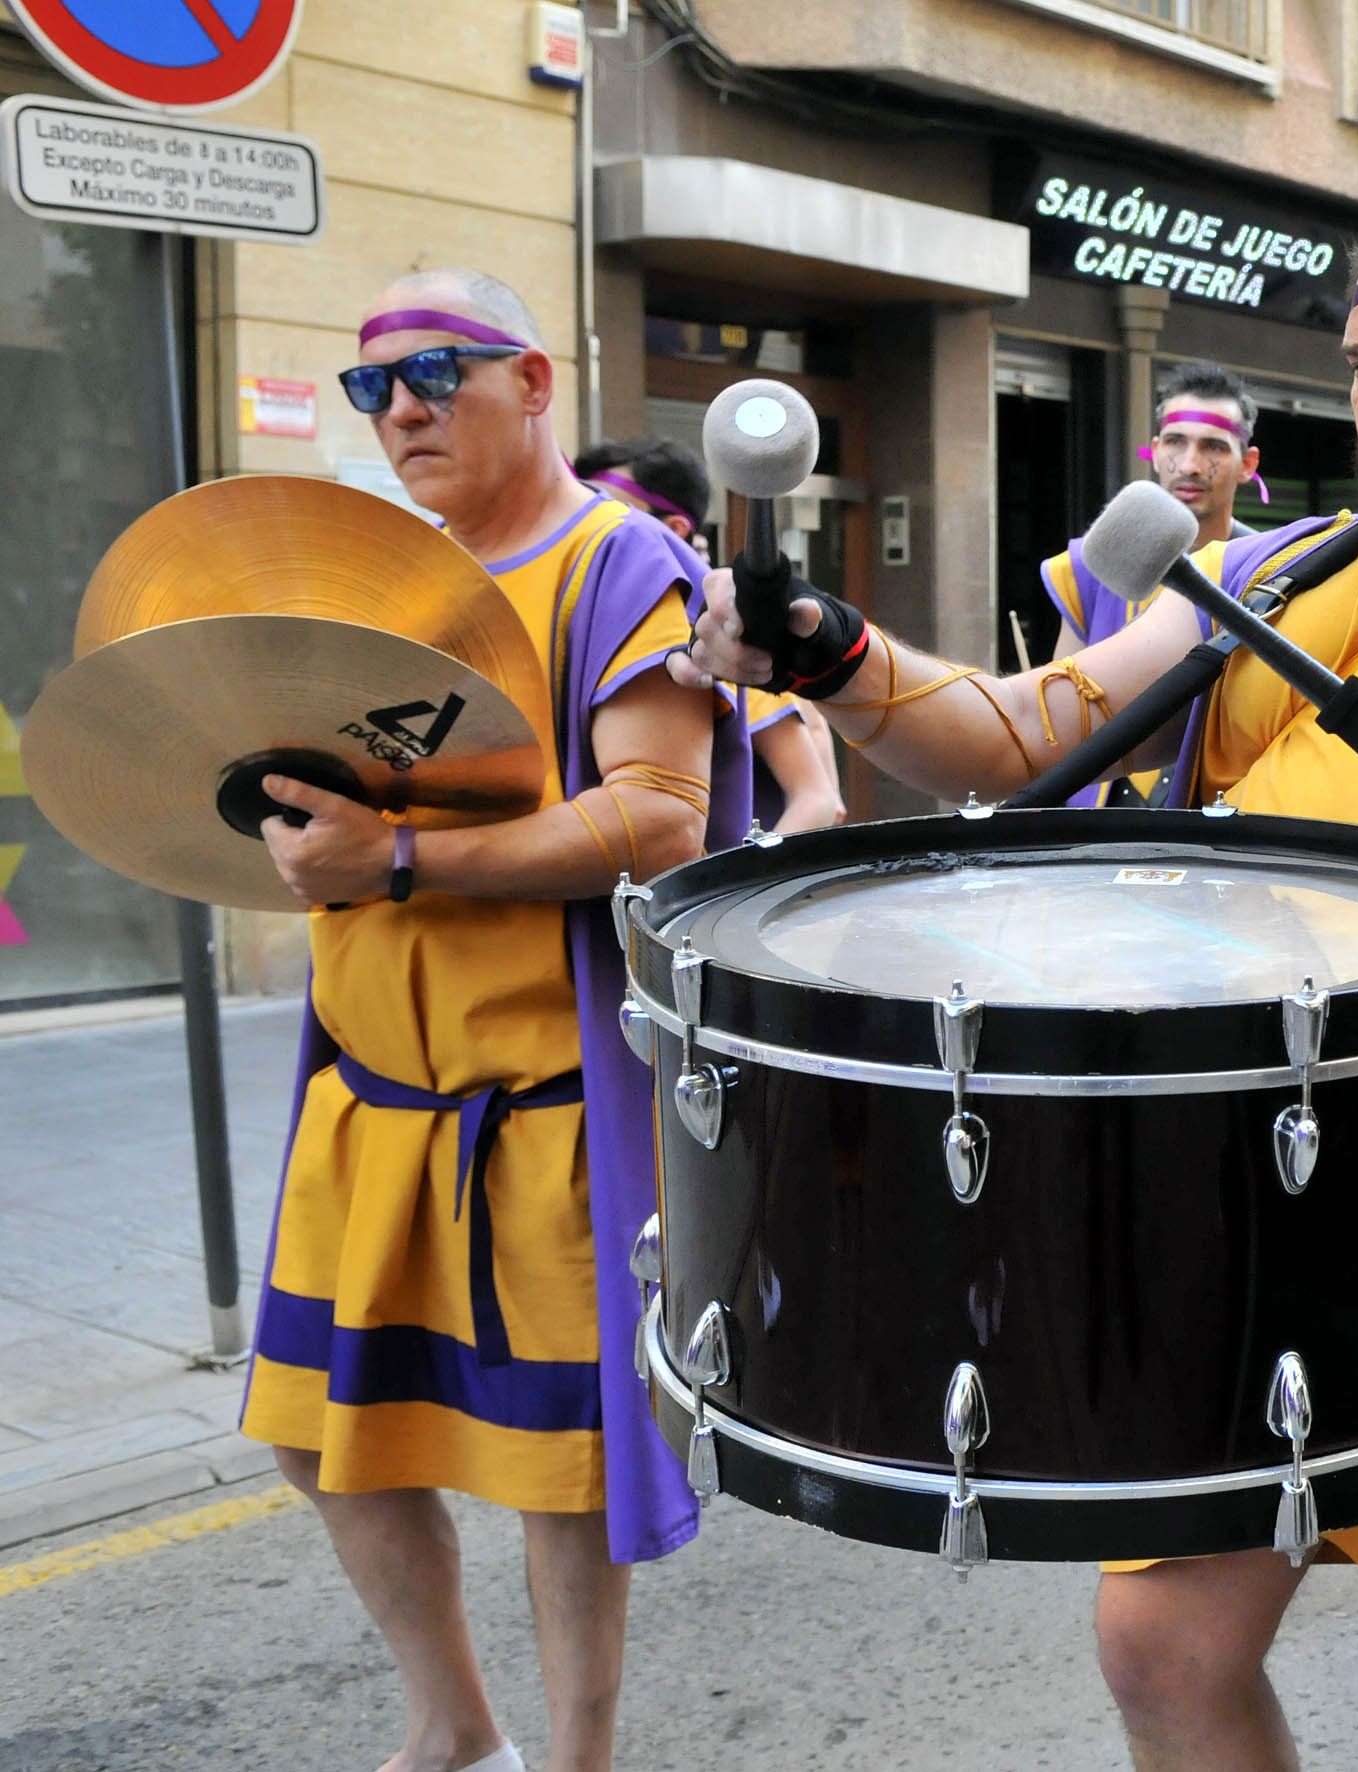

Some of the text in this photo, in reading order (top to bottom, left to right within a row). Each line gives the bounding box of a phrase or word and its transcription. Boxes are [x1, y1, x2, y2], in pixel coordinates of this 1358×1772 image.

[36, 117, 160, 154] Laborables
[164, 137, 192, 157] de
[214, 147, 228, 162] a
[43, 147, 296, 199] Excepto Carga y Descarga
[69, 178, 276, 220] Máximo 30 minutos
[1036, 177, 1334, 276] SALÓN DE JUEGO
[1074, 236, 1265, 307] CAFETERÍA
